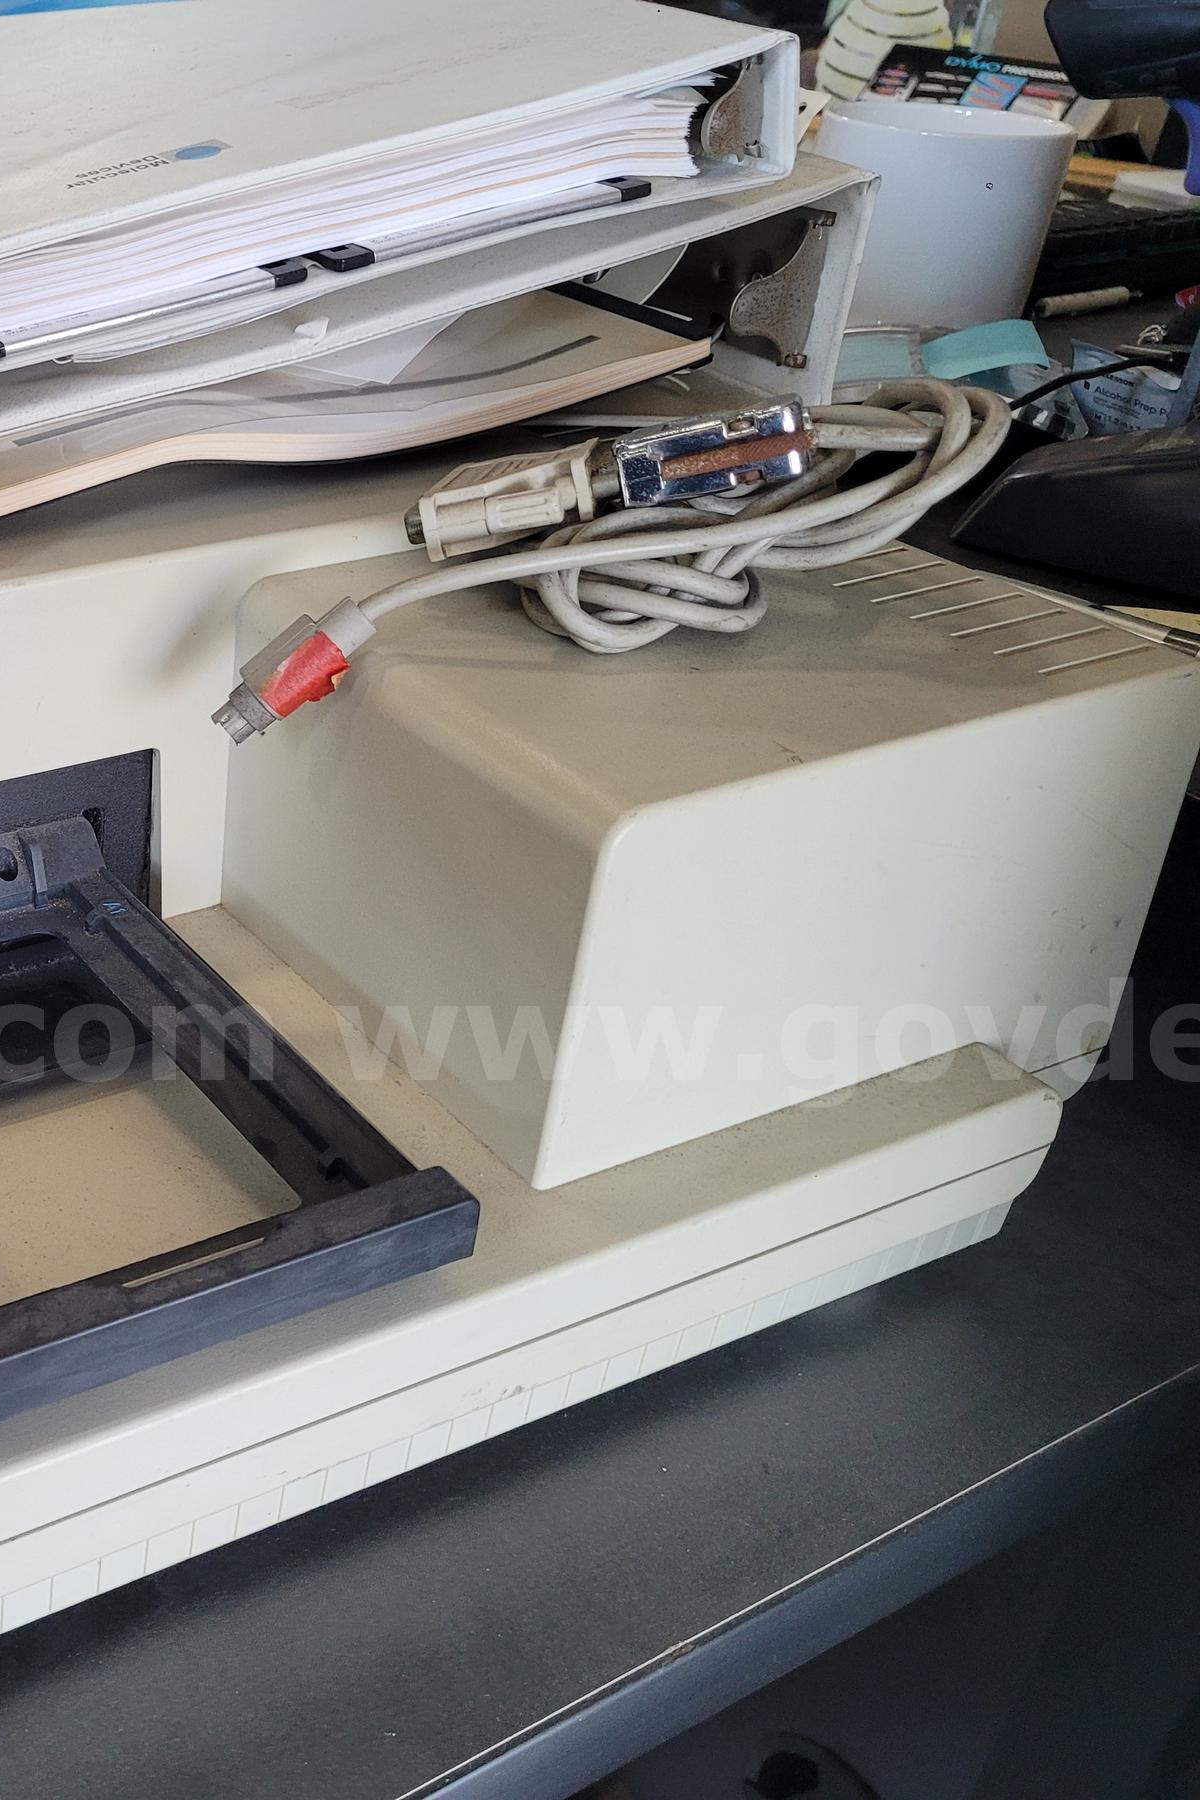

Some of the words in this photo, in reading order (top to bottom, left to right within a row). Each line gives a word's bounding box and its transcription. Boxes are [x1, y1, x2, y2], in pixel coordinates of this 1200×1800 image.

[66, 160, 170, 189] Molecular
[75, 155, 159, 178] Devices
[1095, 386, 1132, 405] Alcohol
[1134, 399, 1157, 415] Prep
